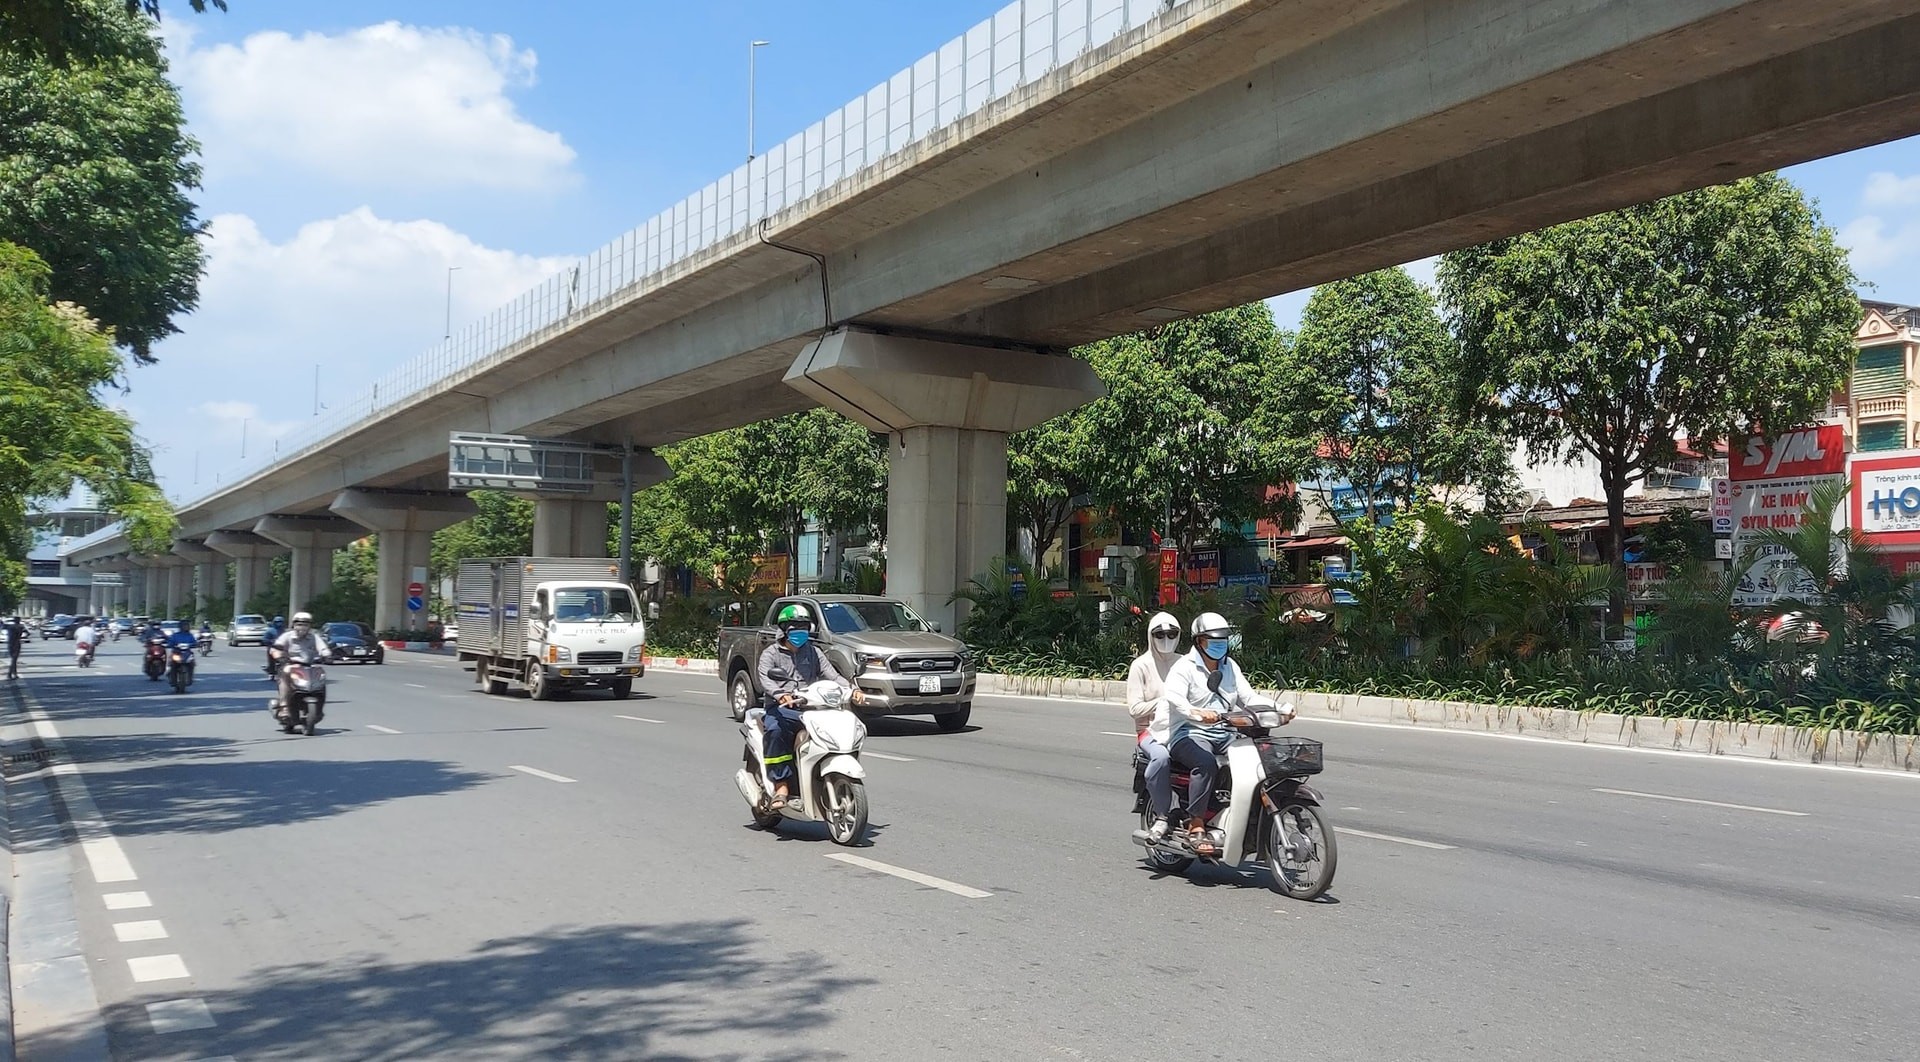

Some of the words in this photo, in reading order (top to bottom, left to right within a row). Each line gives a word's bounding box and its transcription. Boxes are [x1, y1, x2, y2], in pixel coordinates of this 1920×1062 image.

[1743, 430, 1826, 475] SYM
[1762, 495, 1776, 508] XE
[1781, 490, 1808, 507] MÁY
[1741, 515, 1768, 529] SYM
[1762, 545, 1772, 555] XE
